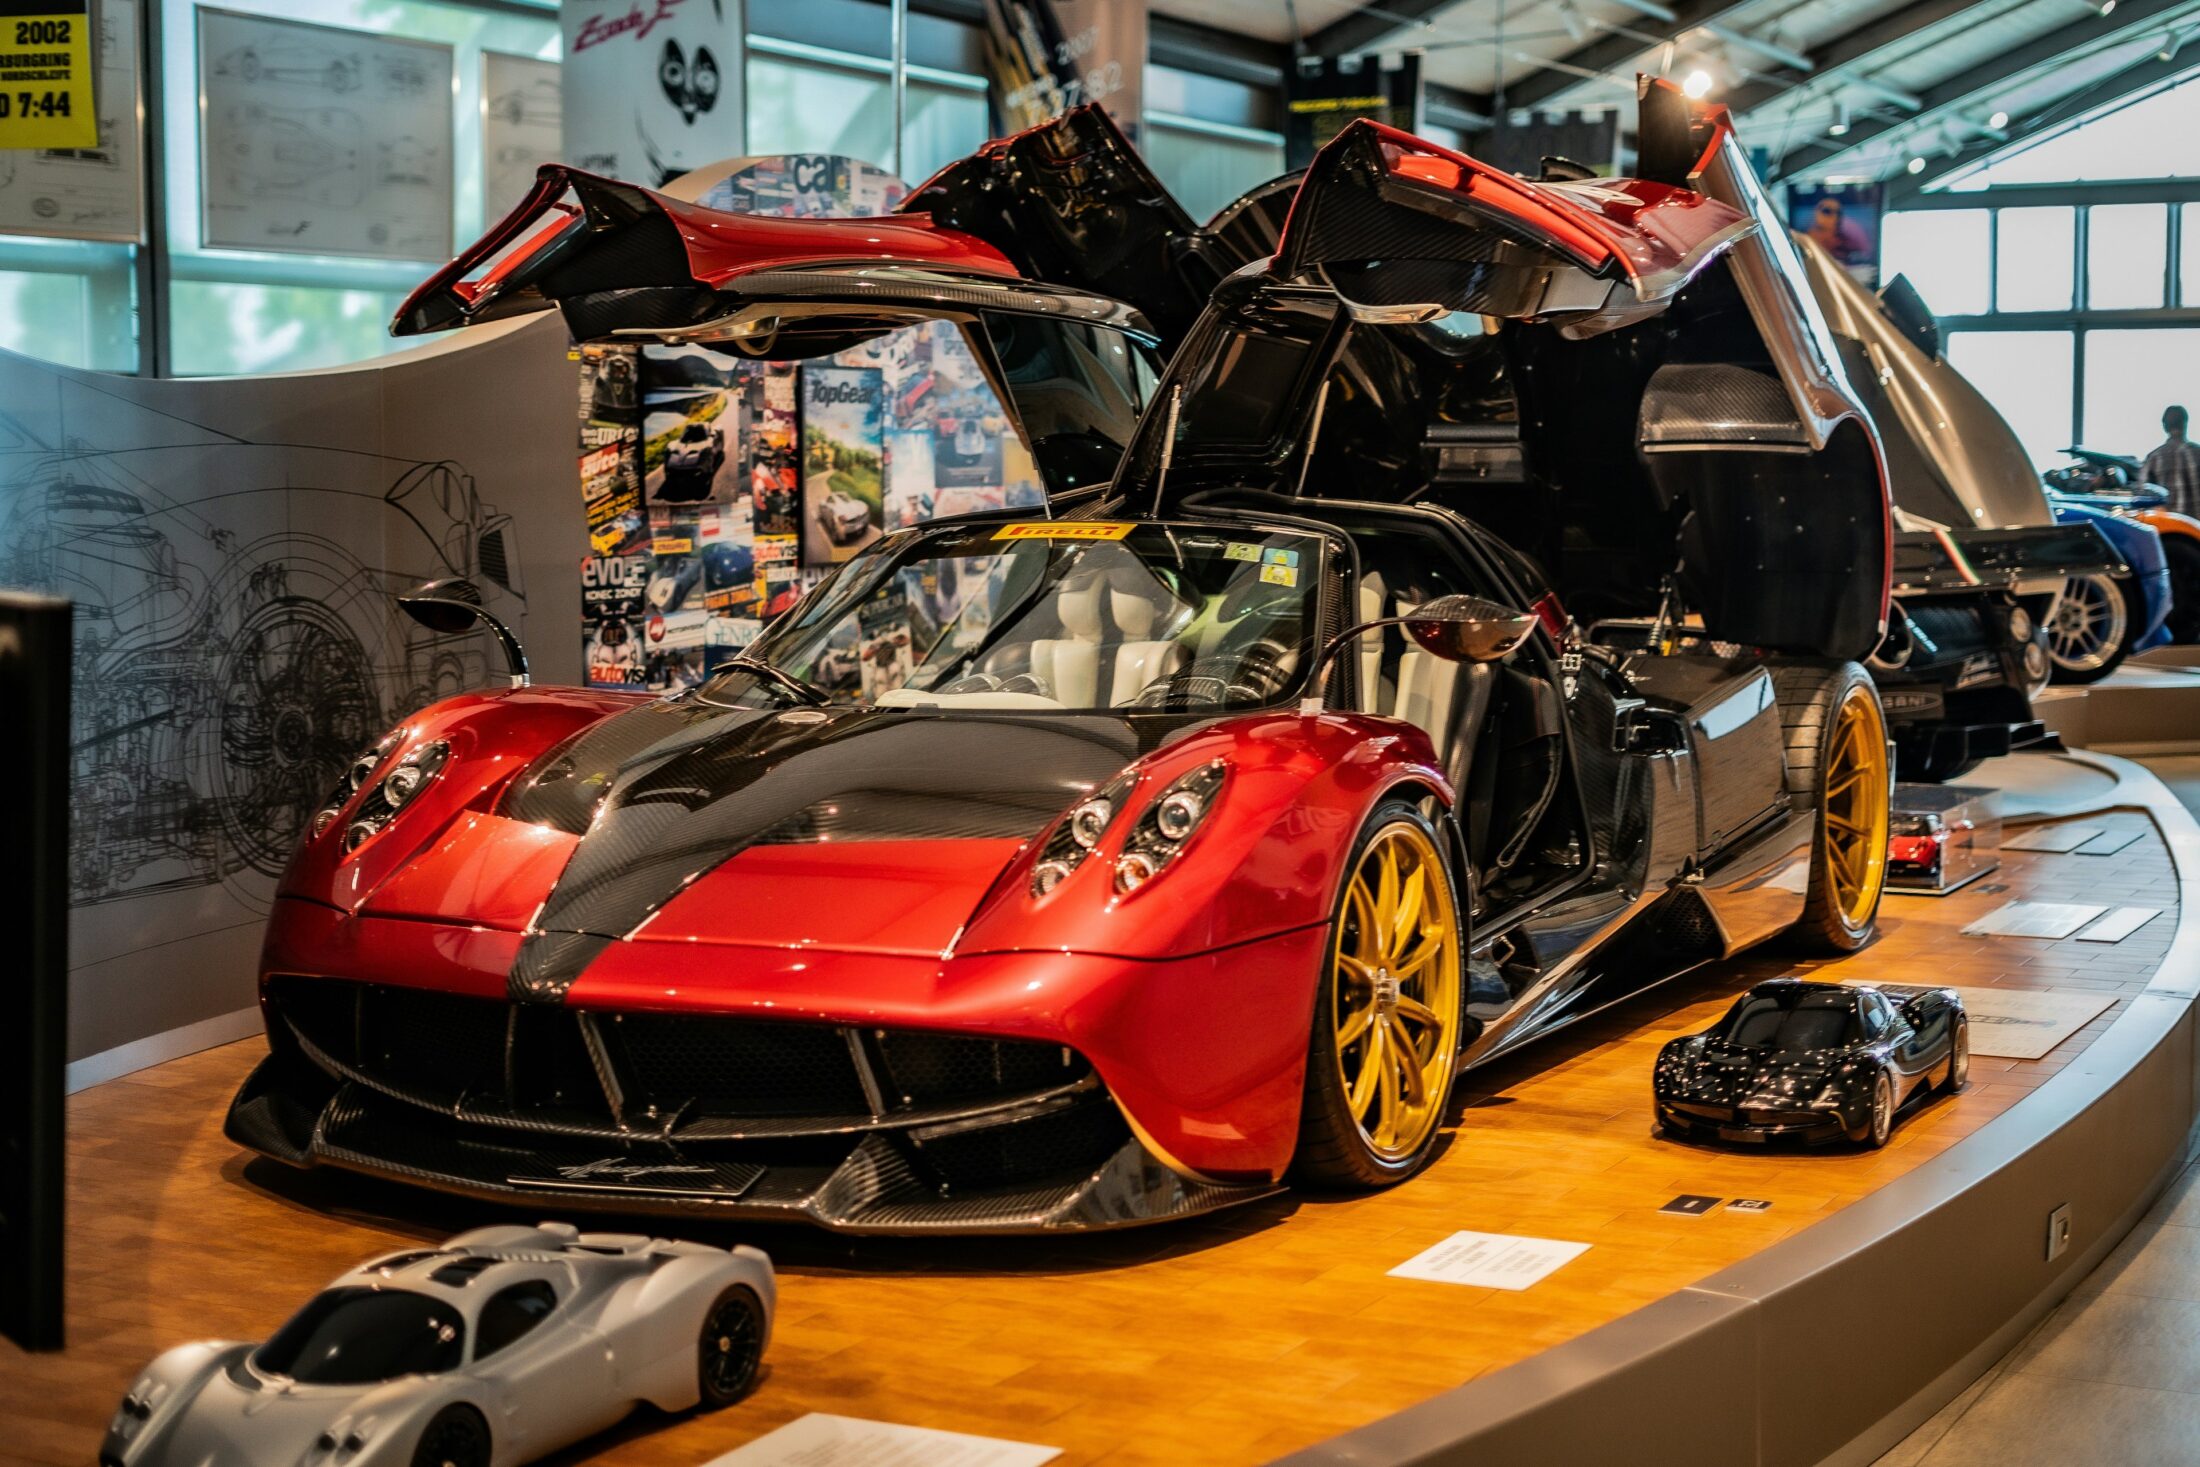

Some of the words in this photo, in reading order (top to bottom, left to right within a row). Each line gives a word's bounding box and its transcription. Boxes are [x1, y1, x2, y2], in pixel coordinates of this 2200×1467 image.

[15, 20, 71, 45] 2002
[17, 91, 71, 118] 7:44
[811, 380, 876, 408] TopGear
[1008, 526, 1120, 536] PIRELLI
[582, 557, 625, 588] evo
